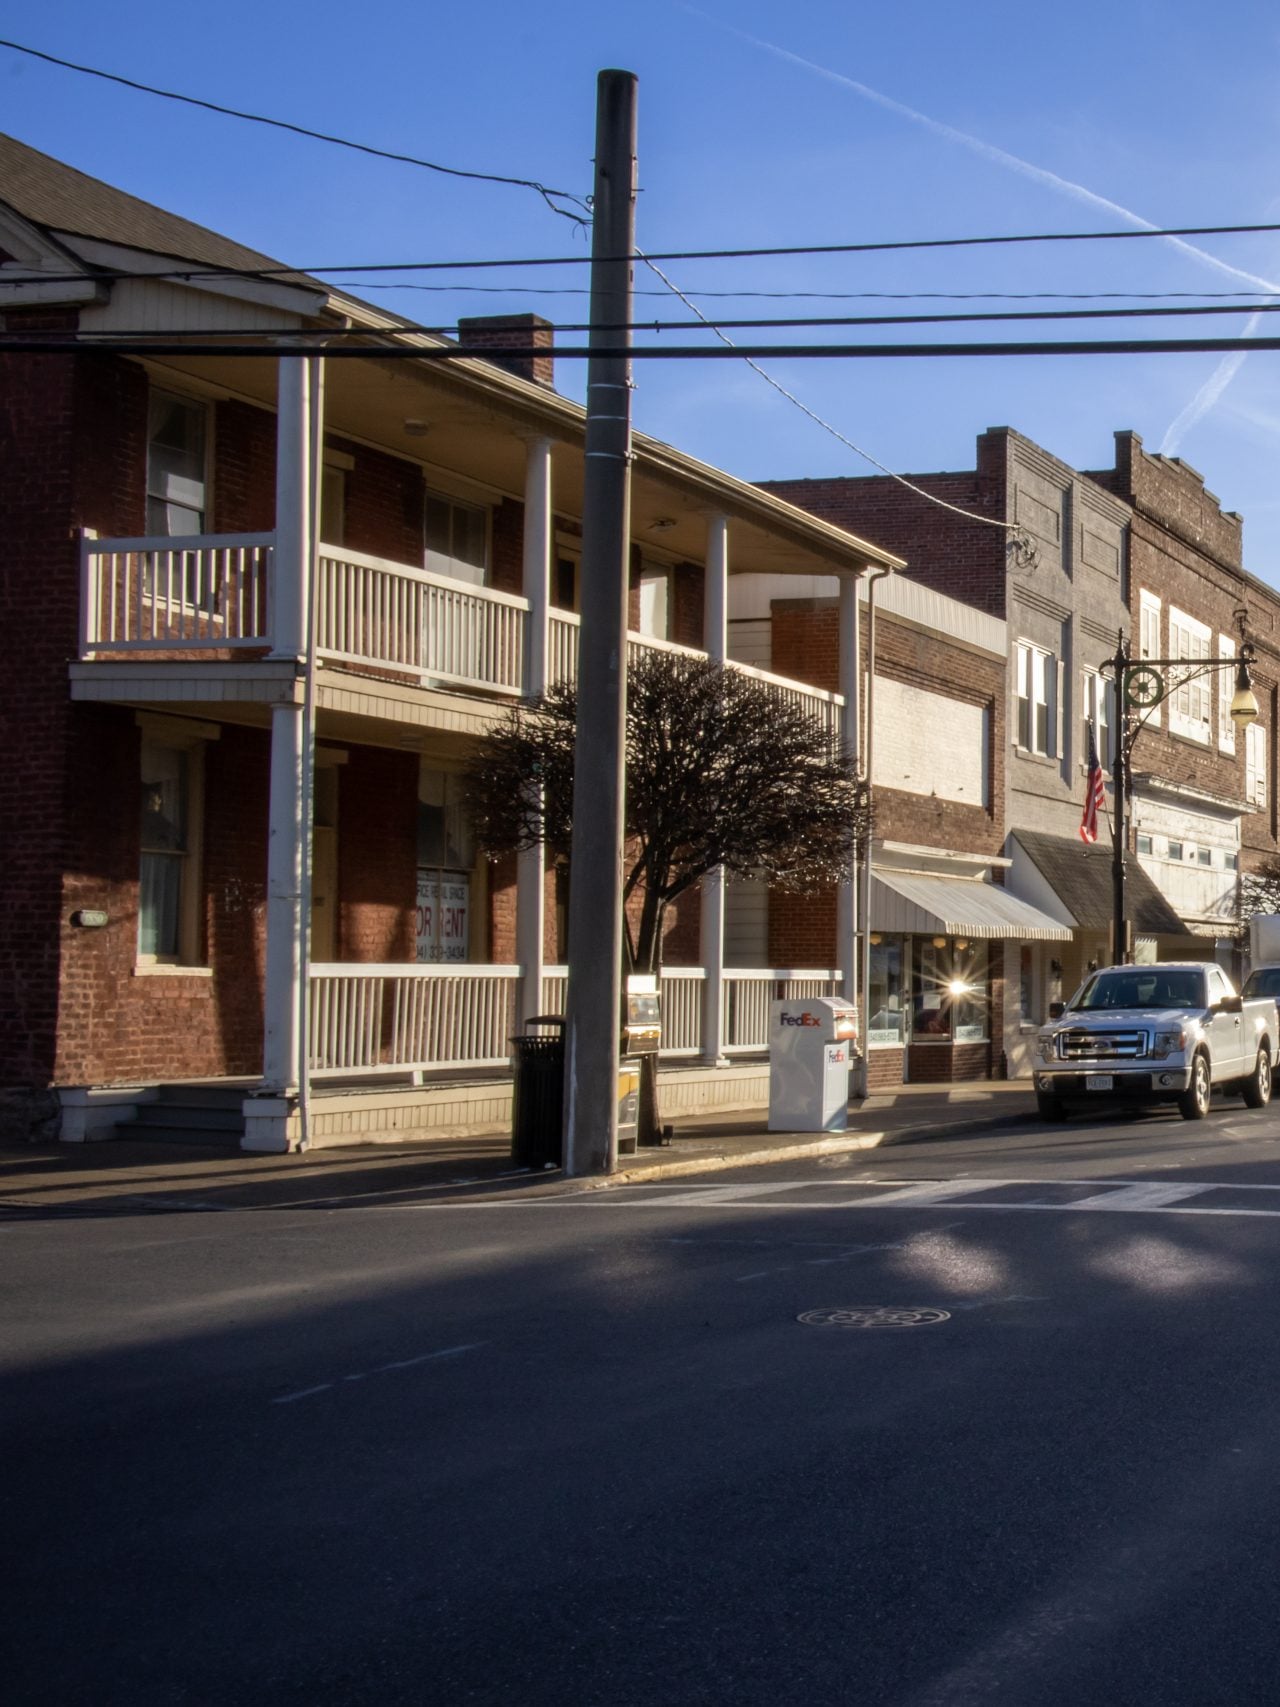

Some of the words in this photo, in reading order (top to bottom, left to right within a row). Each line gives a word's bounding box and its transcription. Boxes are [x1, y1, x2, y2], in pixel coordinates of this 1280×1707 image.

[416, 906, 432, 937] OR
[780, 1012, 822, 1027] FedEx
[829, 1050, 845, 1062] FedEx
